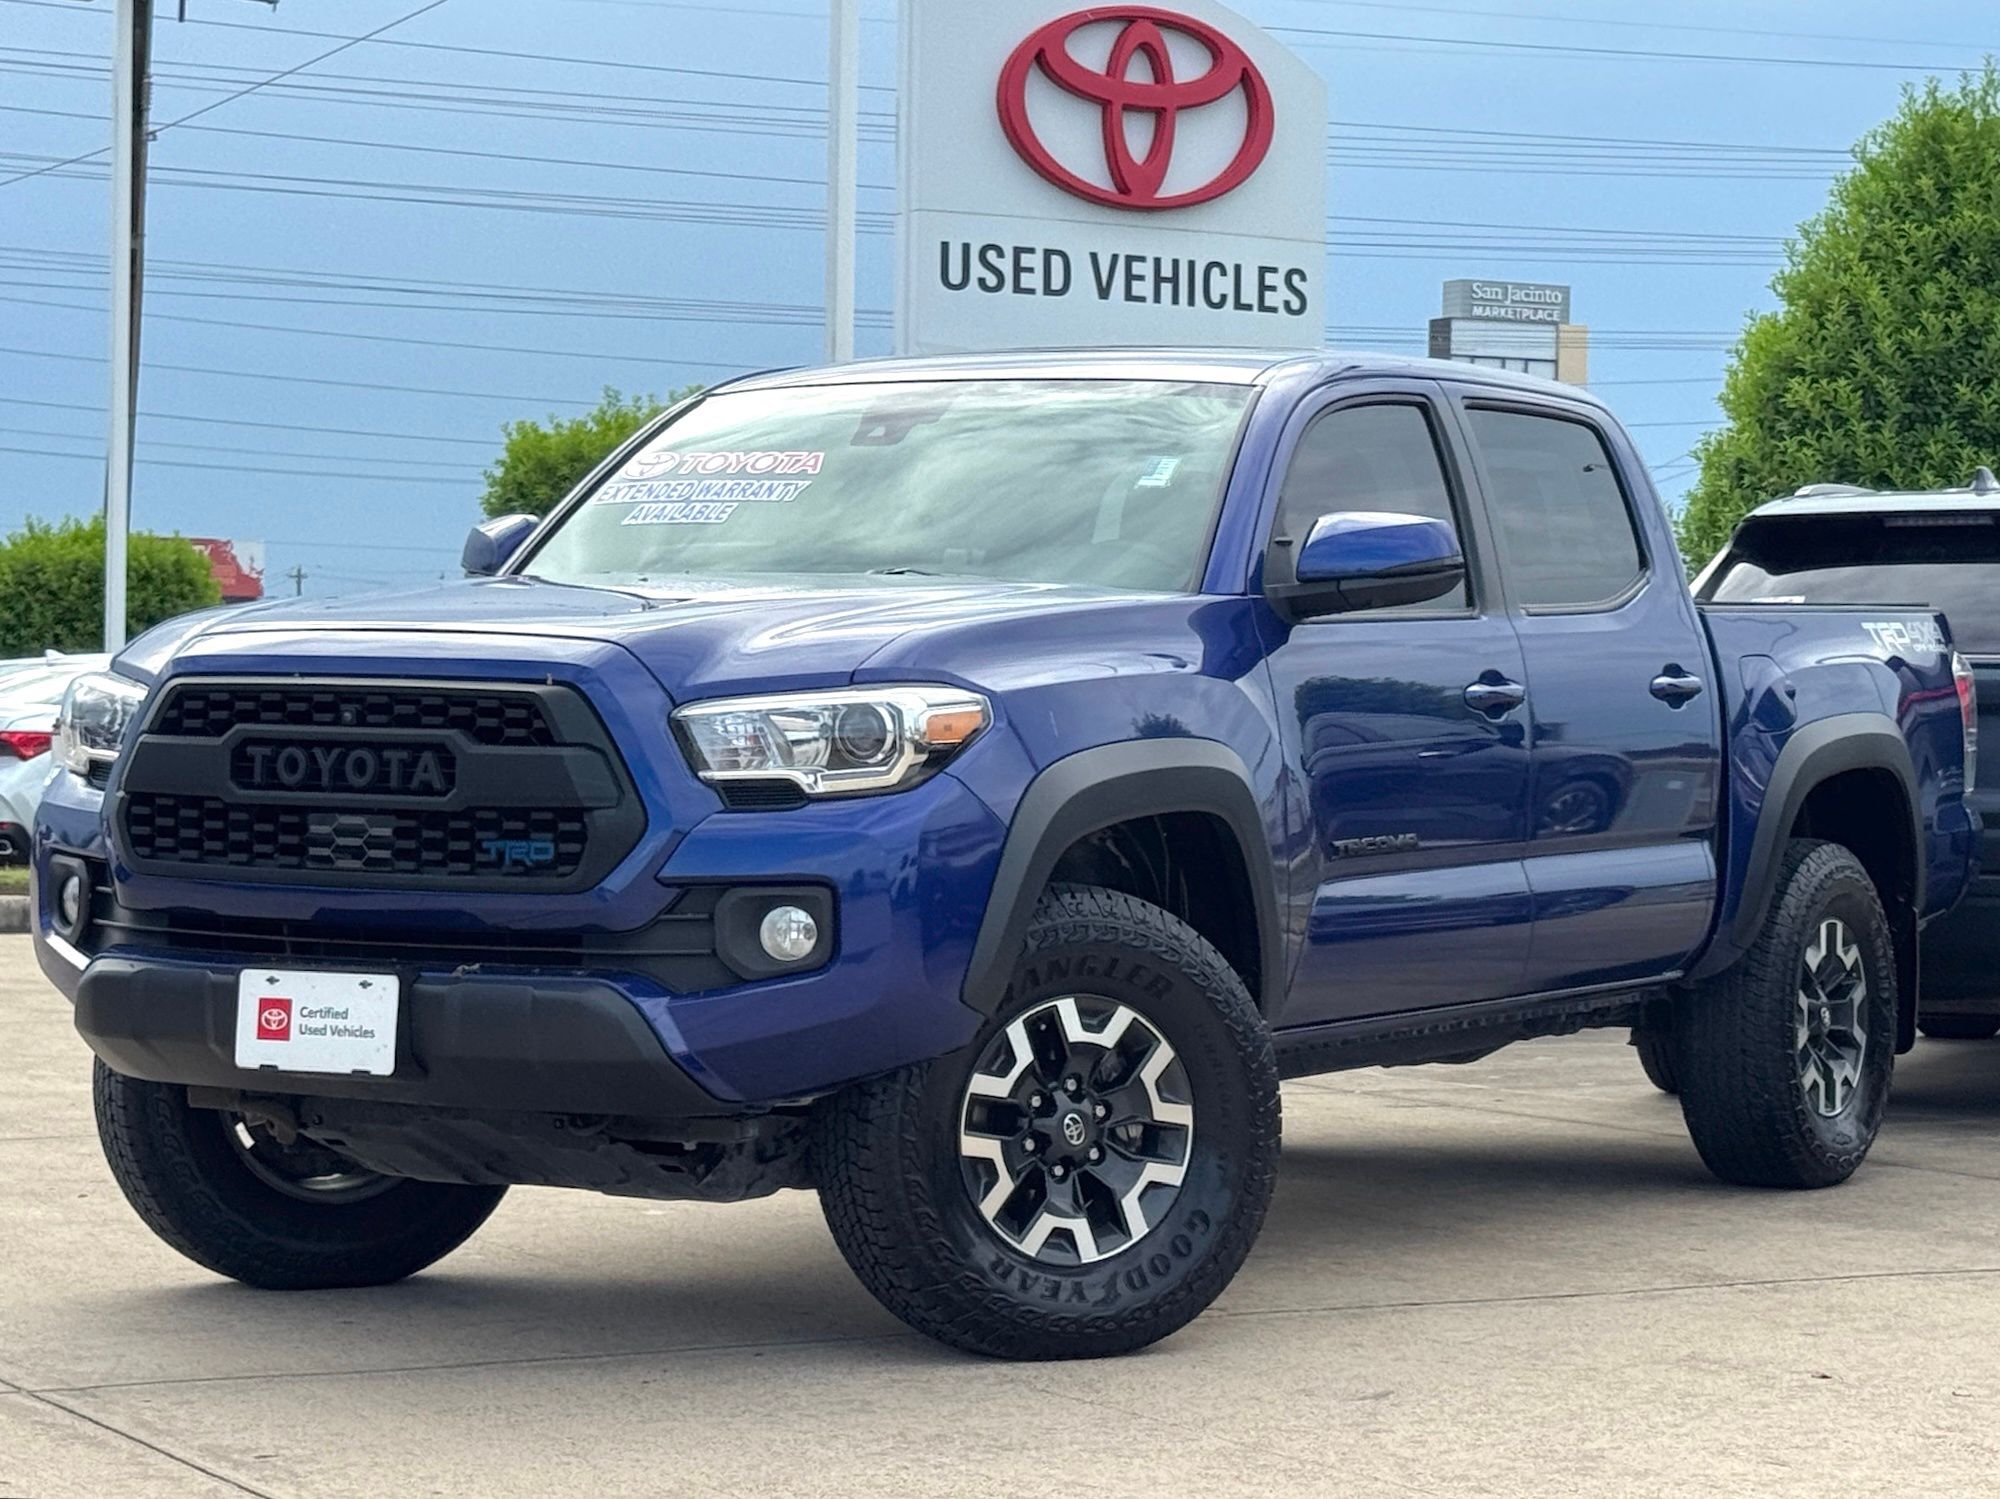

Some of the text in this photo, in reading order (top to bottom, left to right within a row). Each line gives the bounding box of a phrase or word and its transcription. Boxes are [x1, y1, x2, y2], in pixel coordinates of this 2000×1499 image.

[940, 241, 1308, 316] USED VEHICLES
[1471, 282, 1562, 304] San Jacinto
[1471, 305, 1561, 321] MARKETPLACE
[682, 452, 825, 475] TOYOTA
[599, 481, 806, 502] EXTENDED WARRANTY
[627, 504, 737, 523] AVAILABLE
[246, 746, 446, 791] TOYOTA
[481, 840, 555, 866] TRD
[1020, 953, 1175, 1001] ANGLER
[299, 1006, 349, 1020] Certified
[299, 1024, 376, 1039] Used Vehicles
